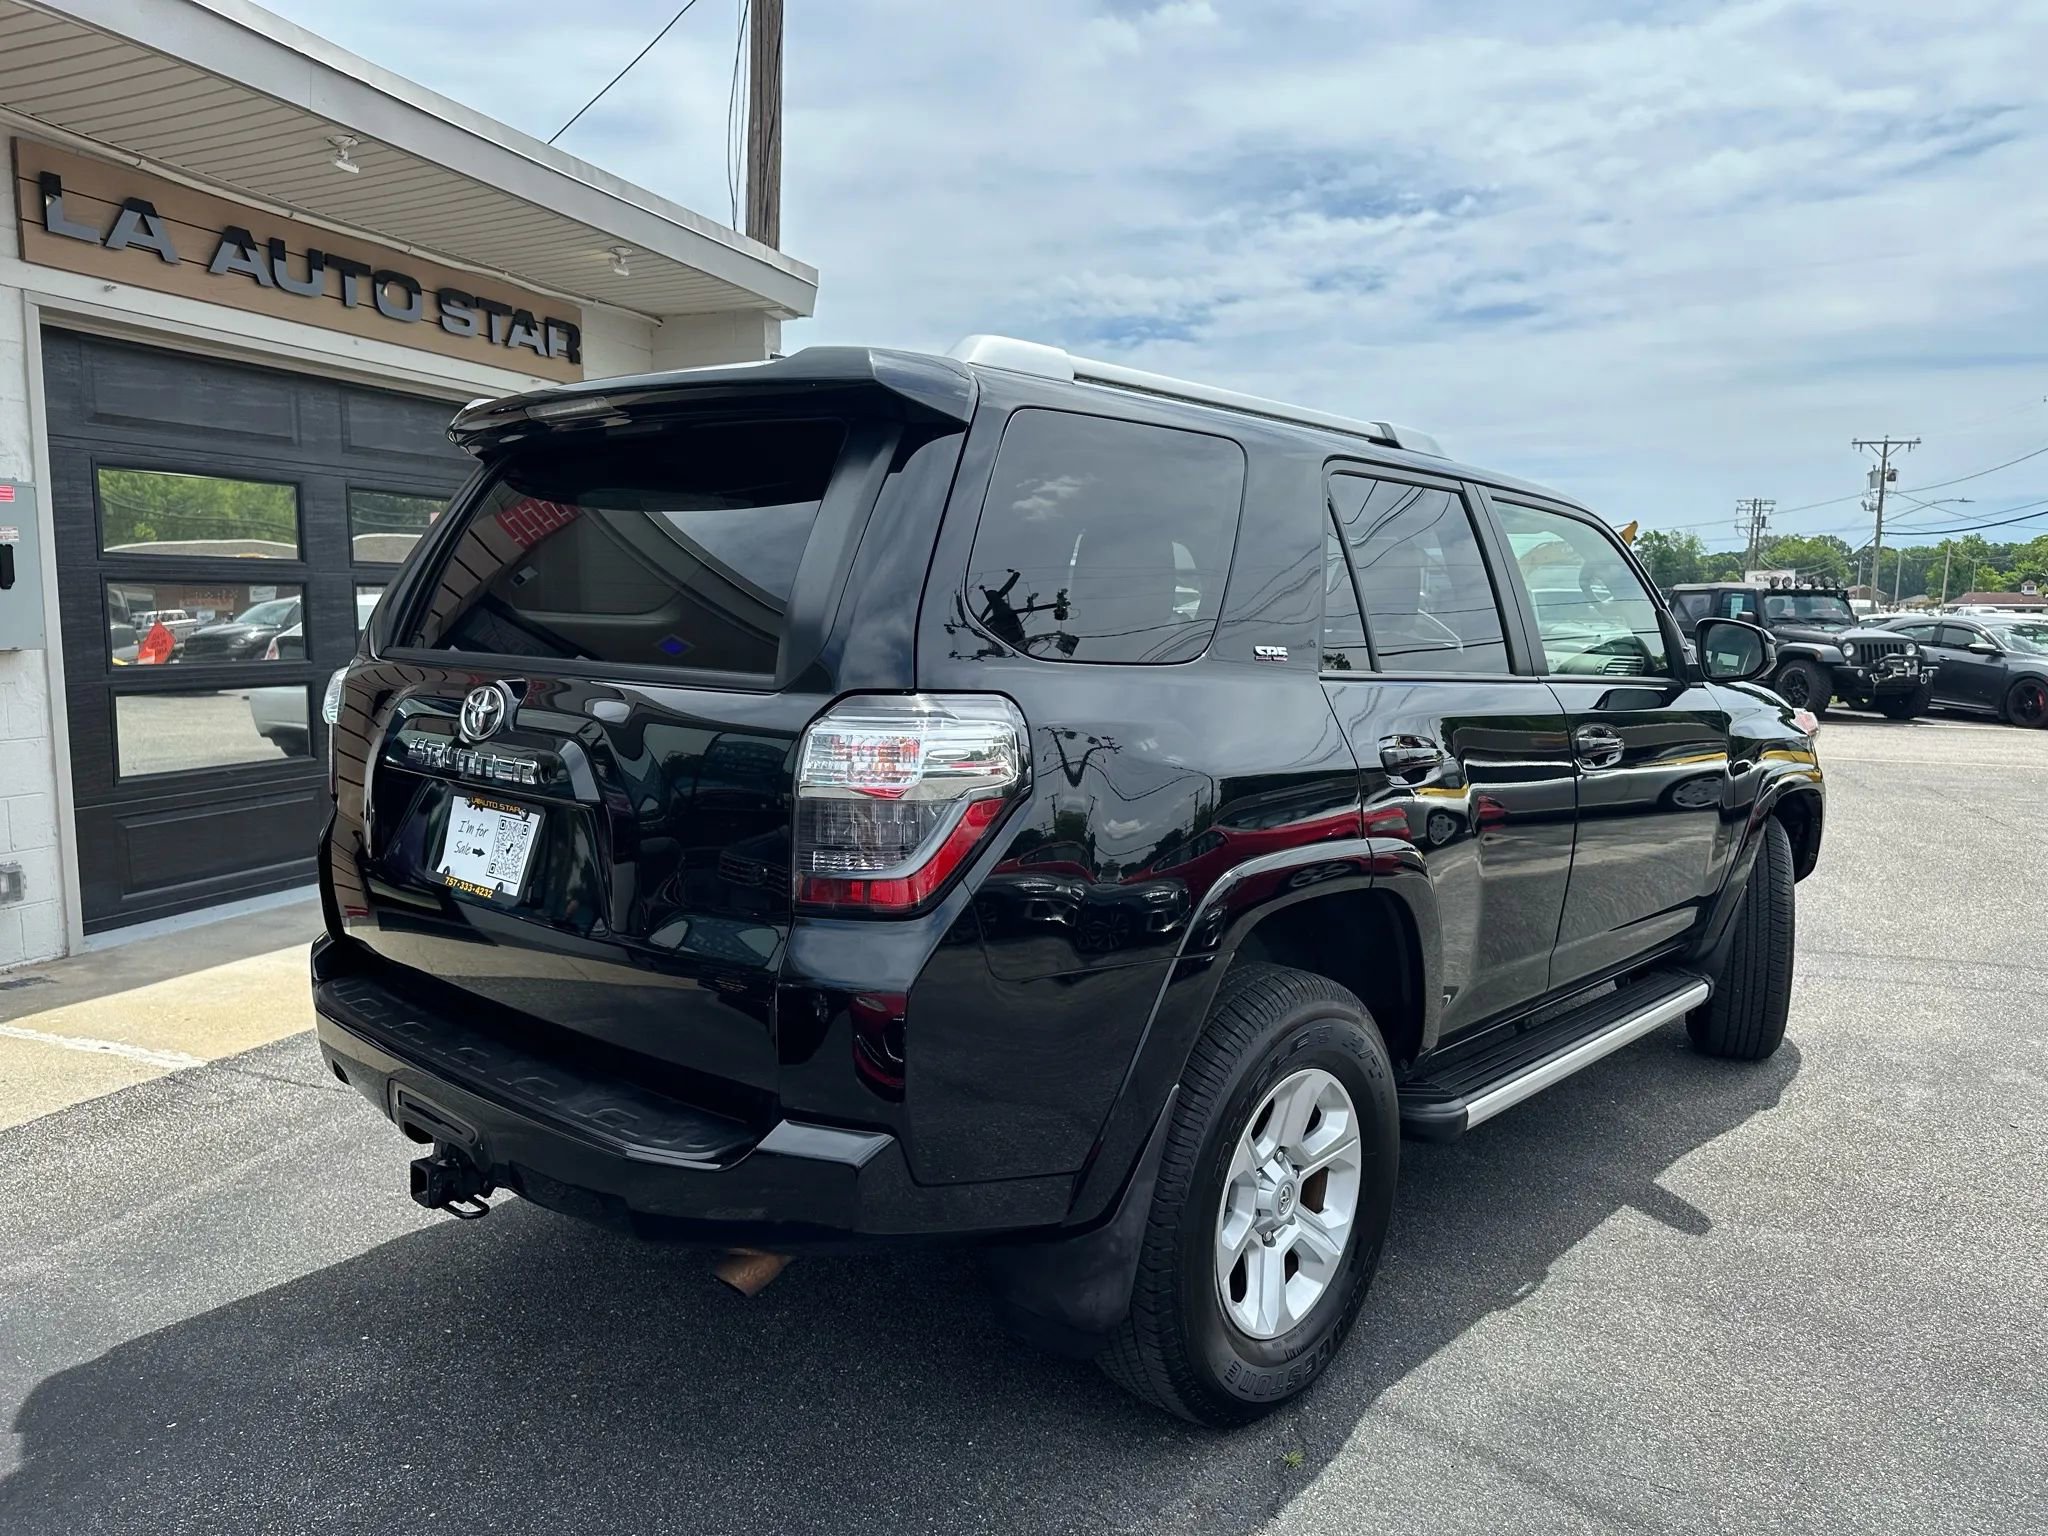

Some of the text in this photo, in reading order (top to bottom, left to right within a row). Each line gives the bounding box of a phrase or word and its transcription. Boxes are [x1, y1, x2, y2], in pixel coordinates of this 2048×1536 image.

[39, 170, 582, 364] LA AUTO STAR
[458, 819, 489, 838] I'm for
[453, 840, 471, 855] Sale
